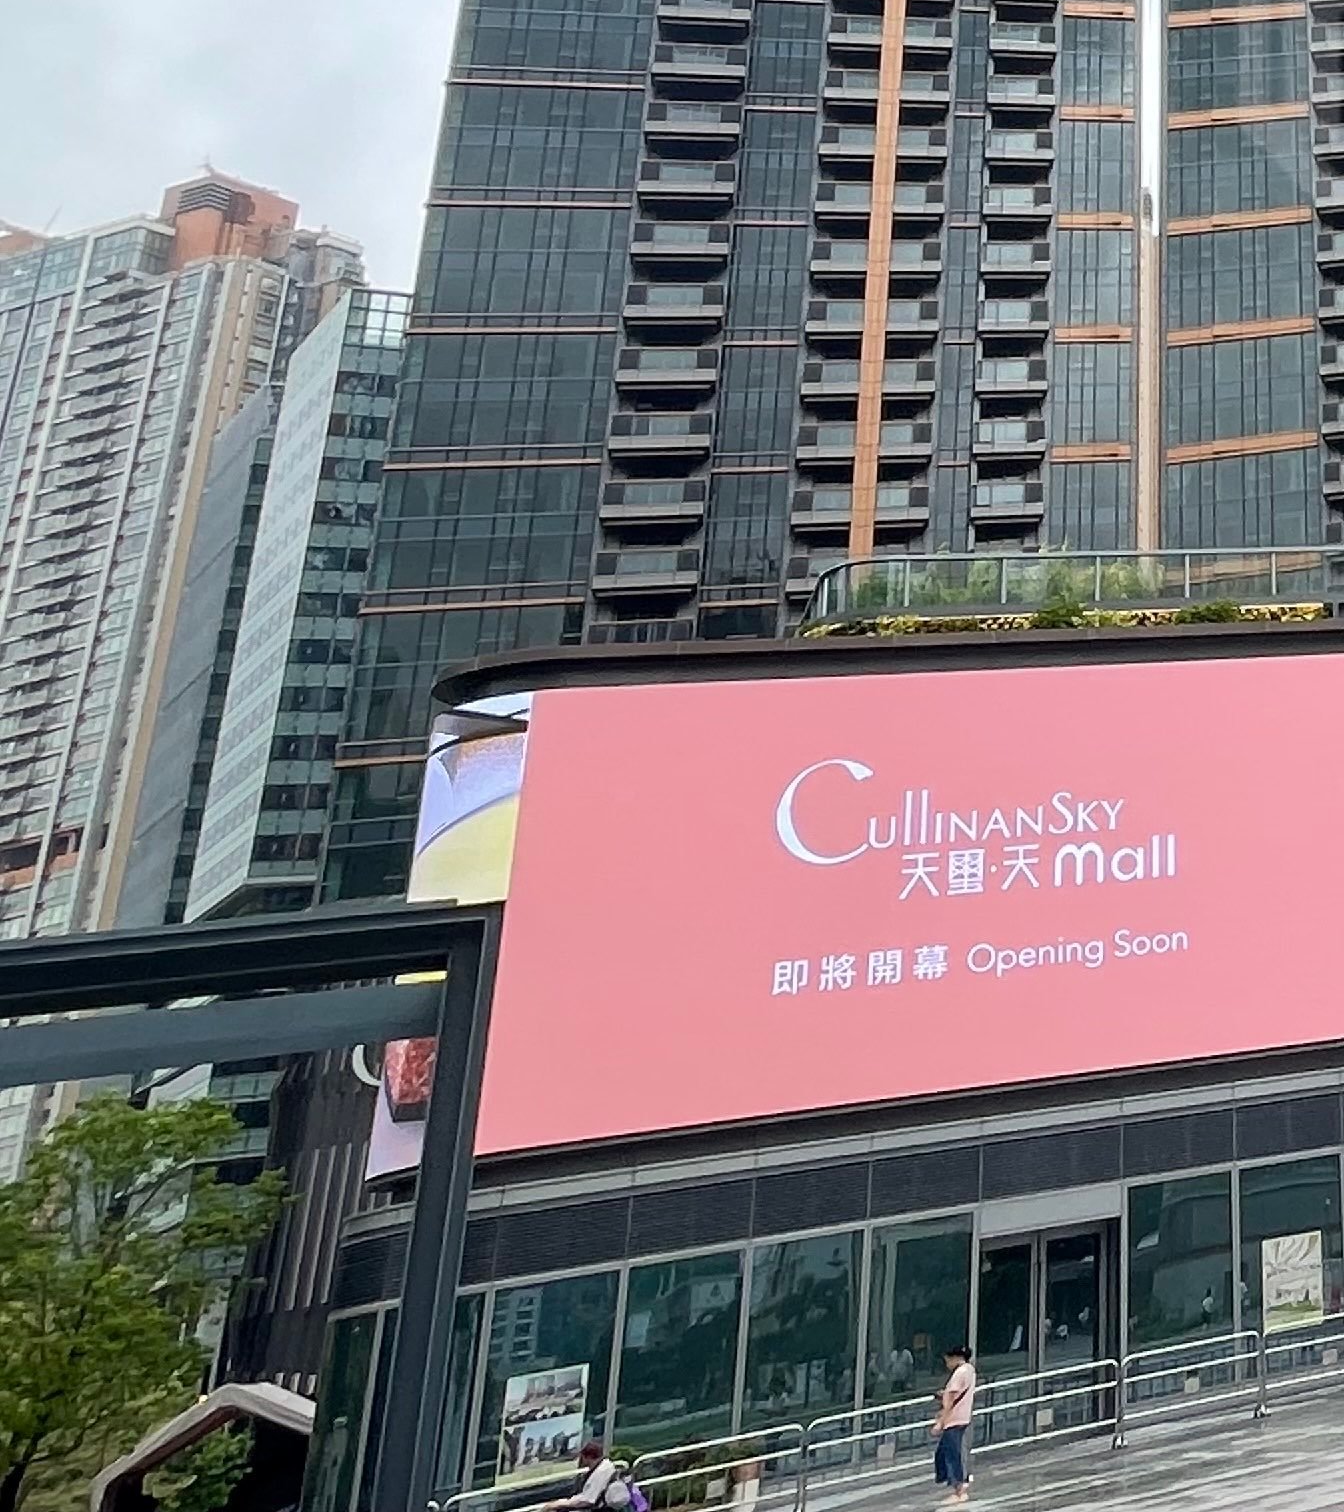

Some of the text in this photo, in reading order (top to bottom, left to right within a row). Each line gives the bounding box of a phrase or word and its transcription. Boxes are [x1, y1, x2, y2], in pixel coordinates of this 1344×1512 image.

[772, 929, 1188, 995] 即將開幕 Opening Soon
